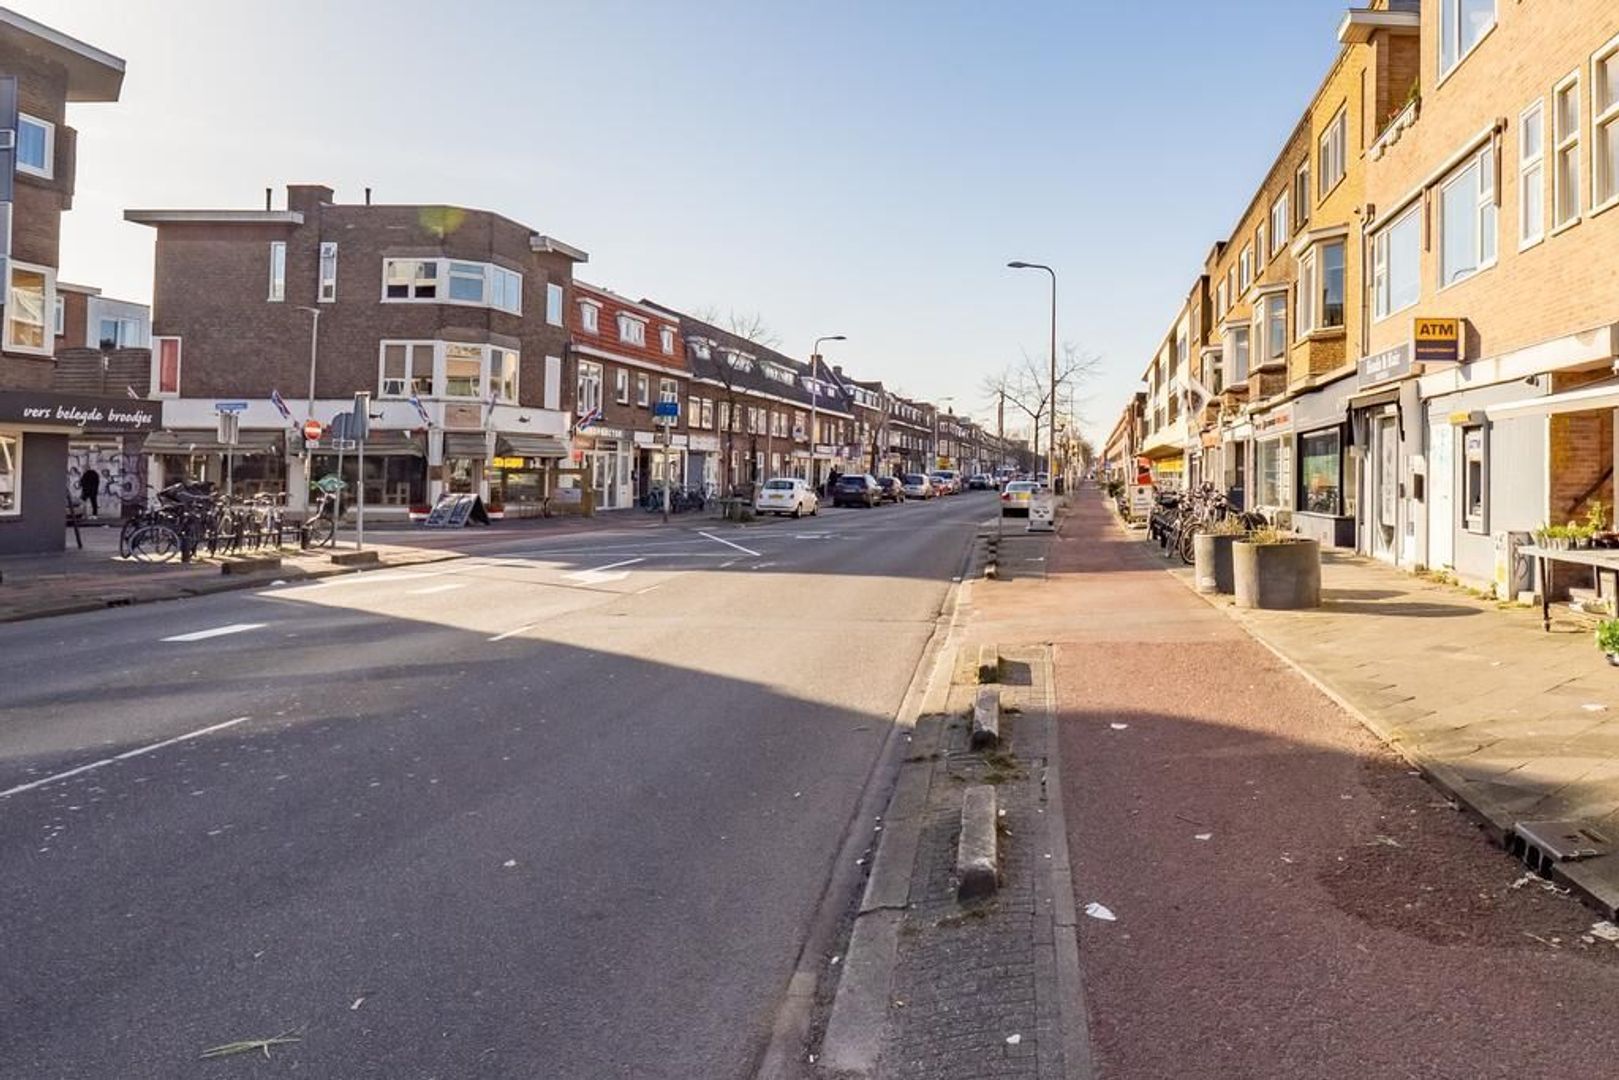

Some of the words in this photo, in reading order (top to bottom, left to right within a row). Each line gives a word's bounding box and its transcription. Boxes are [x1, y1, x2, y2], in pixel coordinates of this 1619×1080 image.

[1420, 323, 1453, 336] ATM
[23, 407, 51, 419] vers
[56, 405, 104, 427] belegde
[108, 408, 152, 428] broodjes
